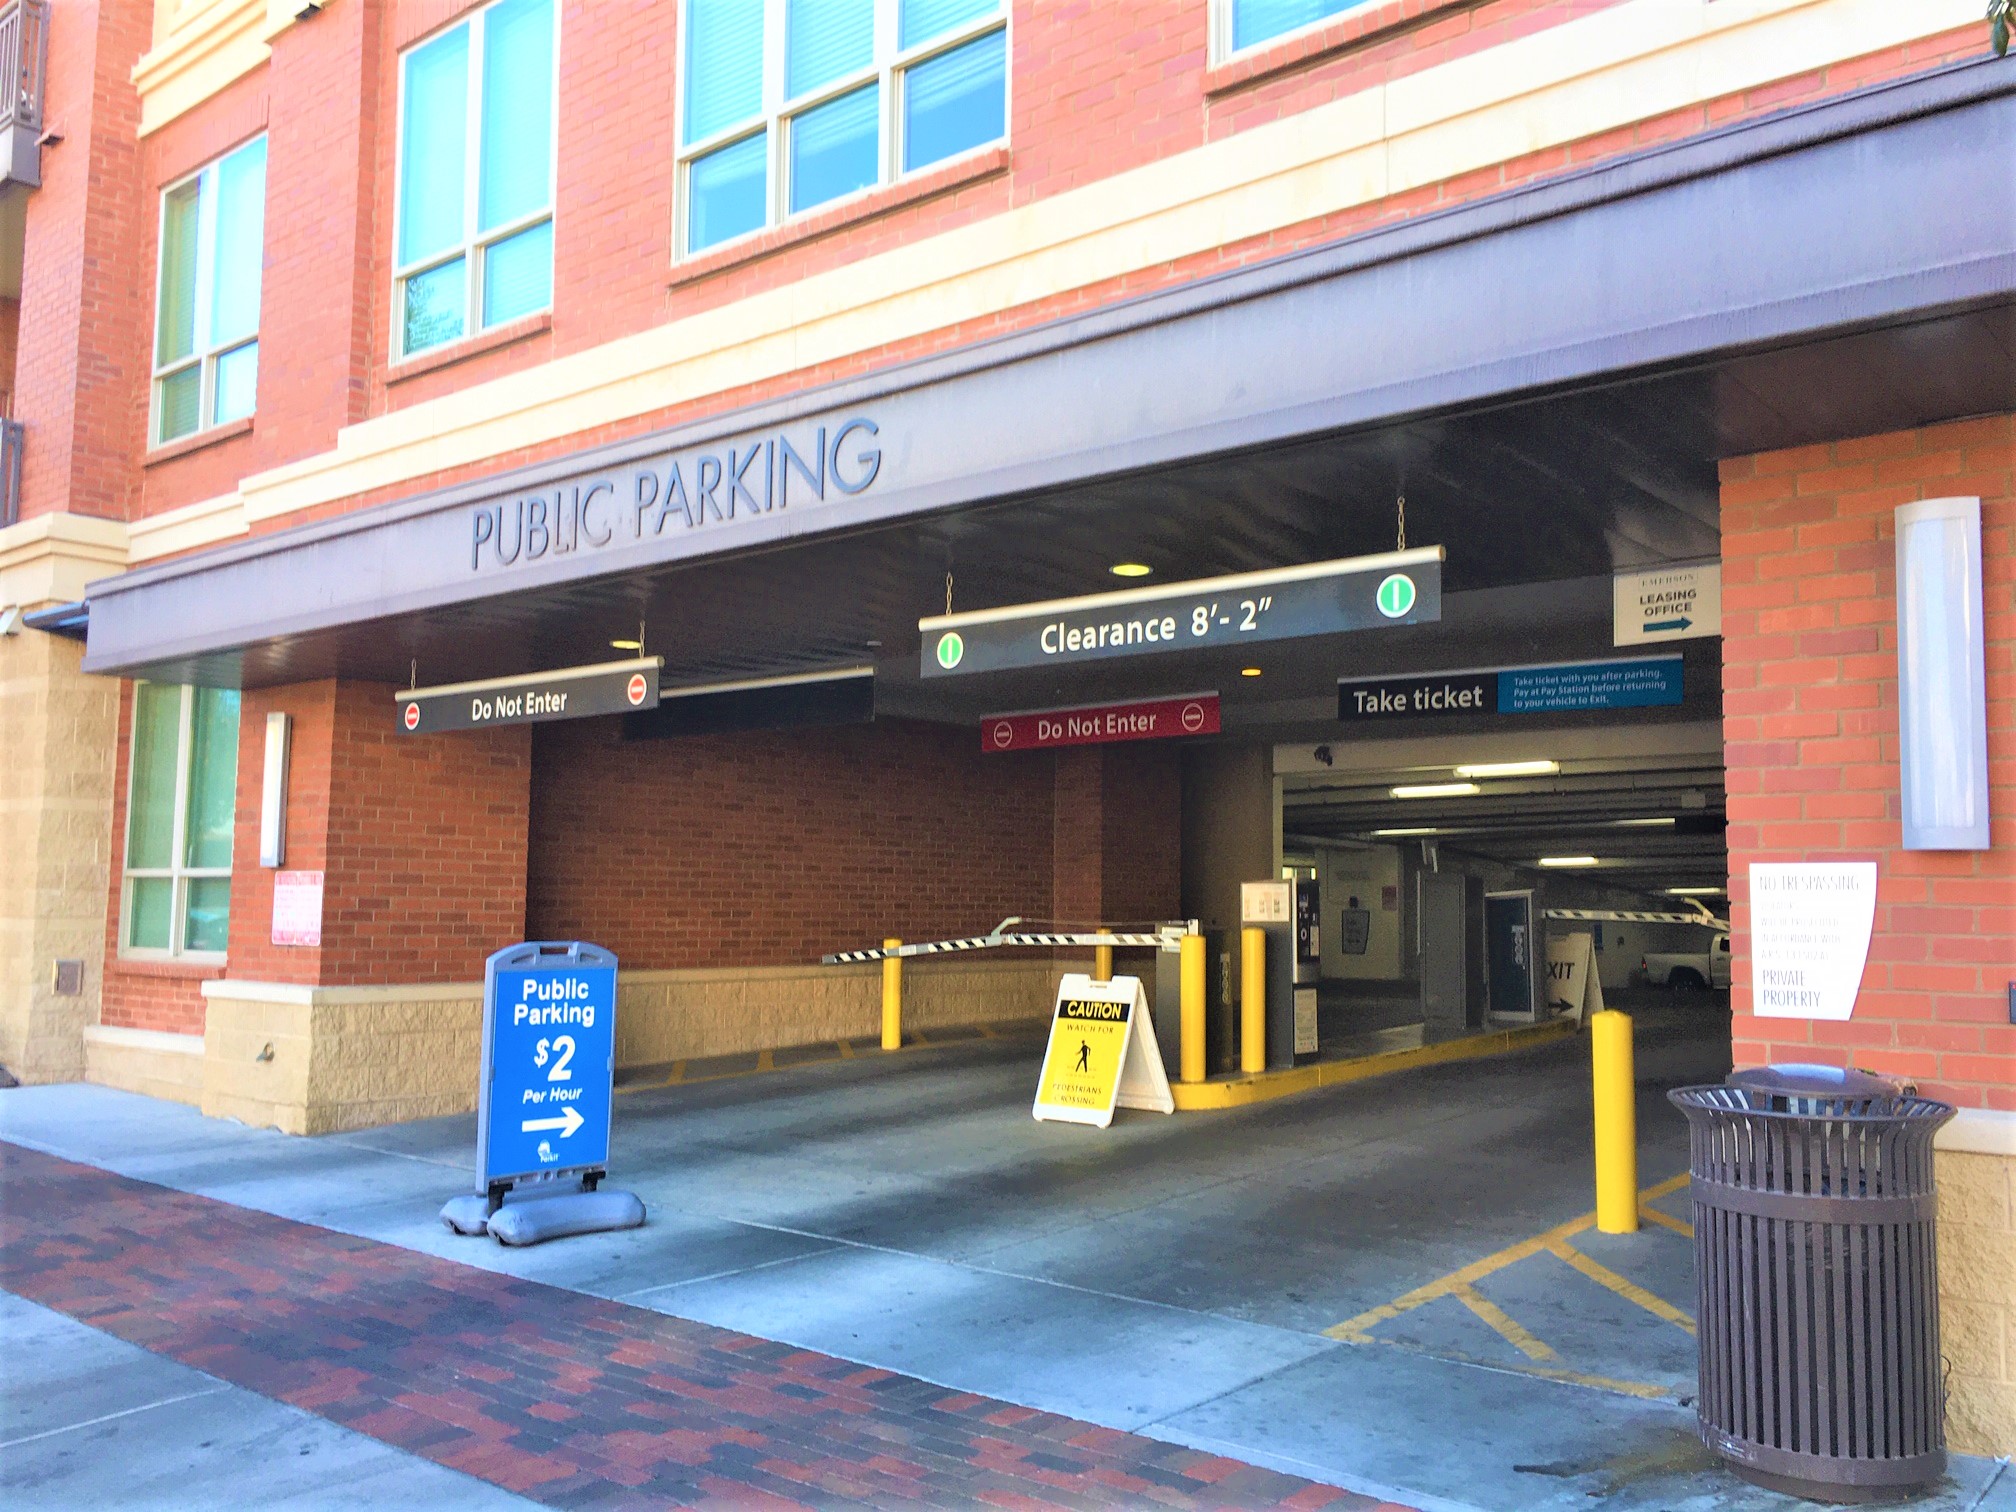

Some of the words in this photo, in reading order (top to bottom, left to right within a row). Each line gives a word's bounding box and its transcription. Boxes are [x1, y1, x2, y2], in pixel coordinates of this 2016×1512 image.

[471, 482, 613, 571] PUBLIC
[634, 416, 882, 538] PARKING
[1639, 588, 1696, 605] LEASING
[1644, 602, 1692, 617] OFFICE
[1040, 616, 1177, 655] Clearance
[1515, 677, 1533, 686] Take
[1535, 675, 1559, 686] ticket
[1561, 673, 1580, 683] with
[1582, 674, 1599, 684] you
[1601, 671, 1622, 681] after
[1513, 687, 1529, 698] Pay
[1530, 687, 1540, 696] at
[1541, 686, 1556, 697] Pay
[1558, 684, 1590, 695] Station
[1591, 681, 1621, 693] before
[1623, 679, 1667, 692] returning
[472, 698, 493, 722] Do
[495, 694, 523, 718] Not
[525, 690, 568, 715] Enter
[1353, 688, 1407, 713] Take
[1413, 684, 1483, 710] ticket
[1513, 699, 1523, 708] to
[1525, 699, 1544, 710] your
[1545, 695, 1577, 707] vehicle
[1578, 696, 1588, 705] to
[1038, 719, 1062, 741] Do
[1068, 716, 1100, 738] Not
[1106, 713, 1157, 735] Enter
[1760, 875, 1777, 891] NO
[1781, 875, 1860, 891] TRESPASSING
[1547, 961, 1575, 980] XIT
[1762, 969, 1807, 986] PRIVATE
[523, 978, 589, 1001] Public
[1763, 989, 1821, 1007] PROPERTY
[514, 1002, 595, 1028] Parking
[1067, 1000, 1122, 1019] CAUTION
[1067, 1024, 1096, 1033] WATCH
[1098, 1026, 1114, 1034] FOR
[533, 1035, 576, 1082] $2
[522, 1089, 547, 1105] Per
[549, 1087, 583, 1102] Hour
[1052, 1083, 1102, 1095] PEDESTRIANS
